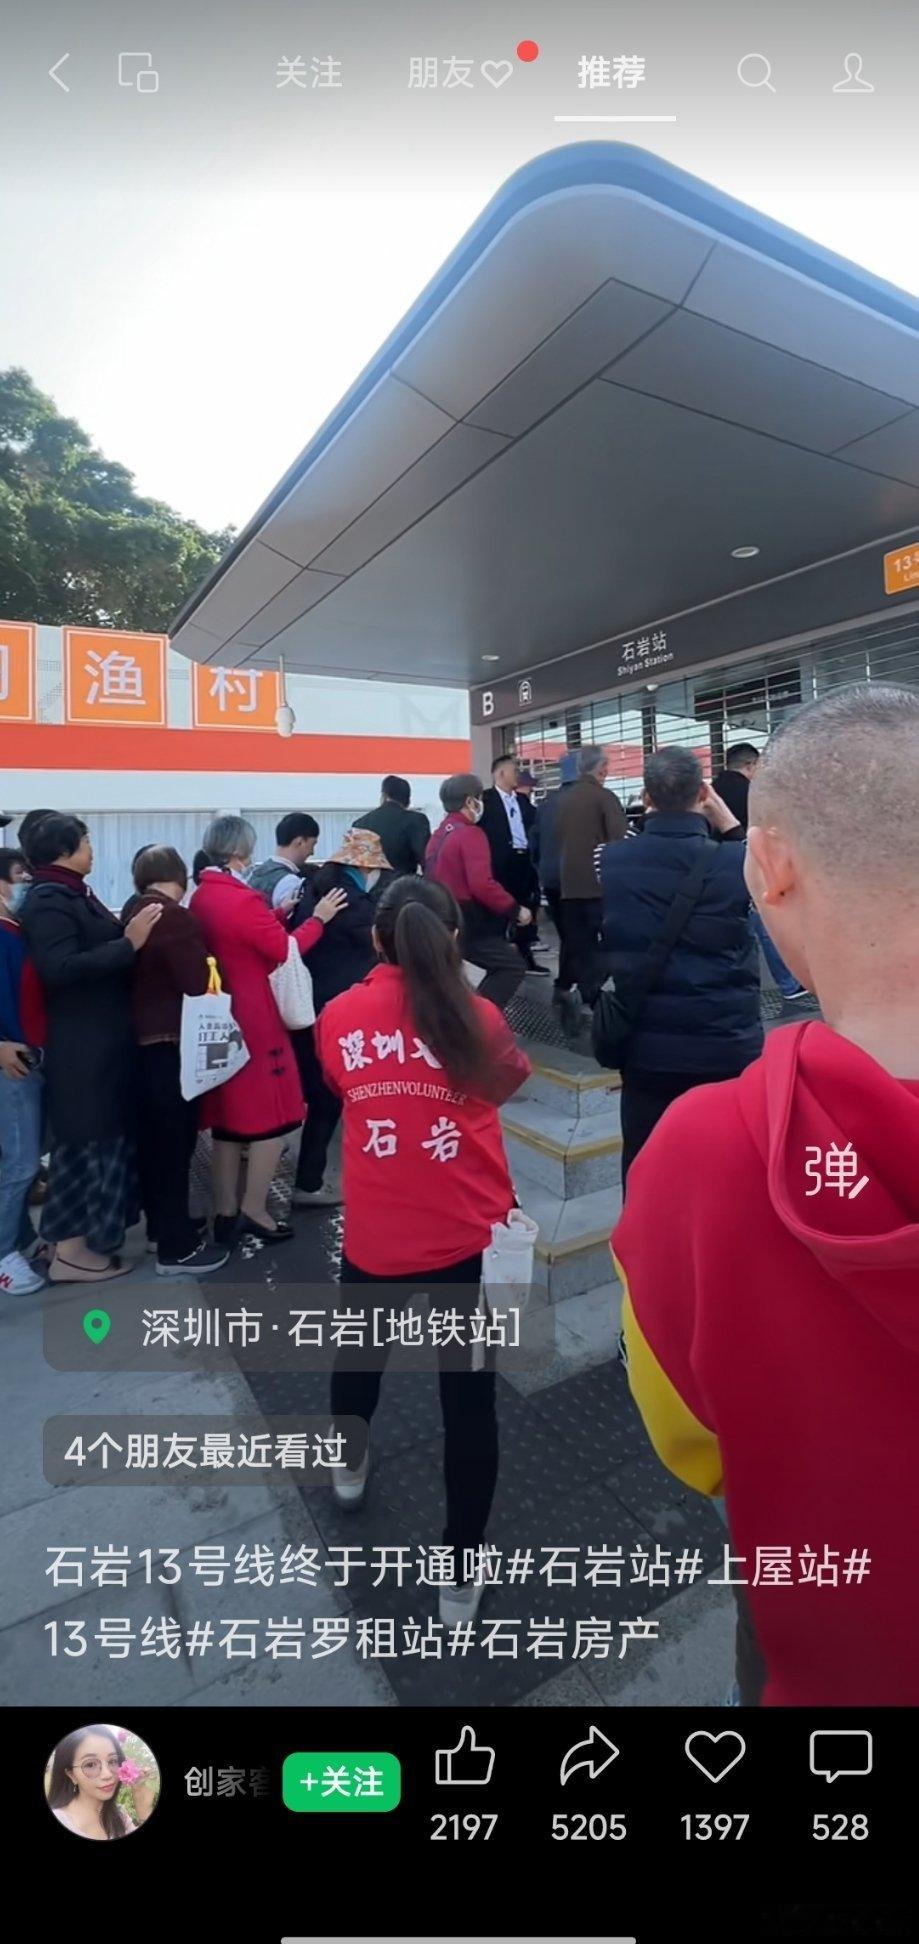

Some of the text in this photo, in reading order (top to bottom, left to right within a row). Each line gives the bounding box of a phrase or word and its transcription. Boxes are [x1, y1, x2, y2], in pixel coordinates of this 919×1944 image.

[621, 630, 667, 662] 石岩站
[617, 653, 674, 676] Shiyan Station
[482, 690, 495, 717] B
[362, 1116, 462, 1162] 石岩
